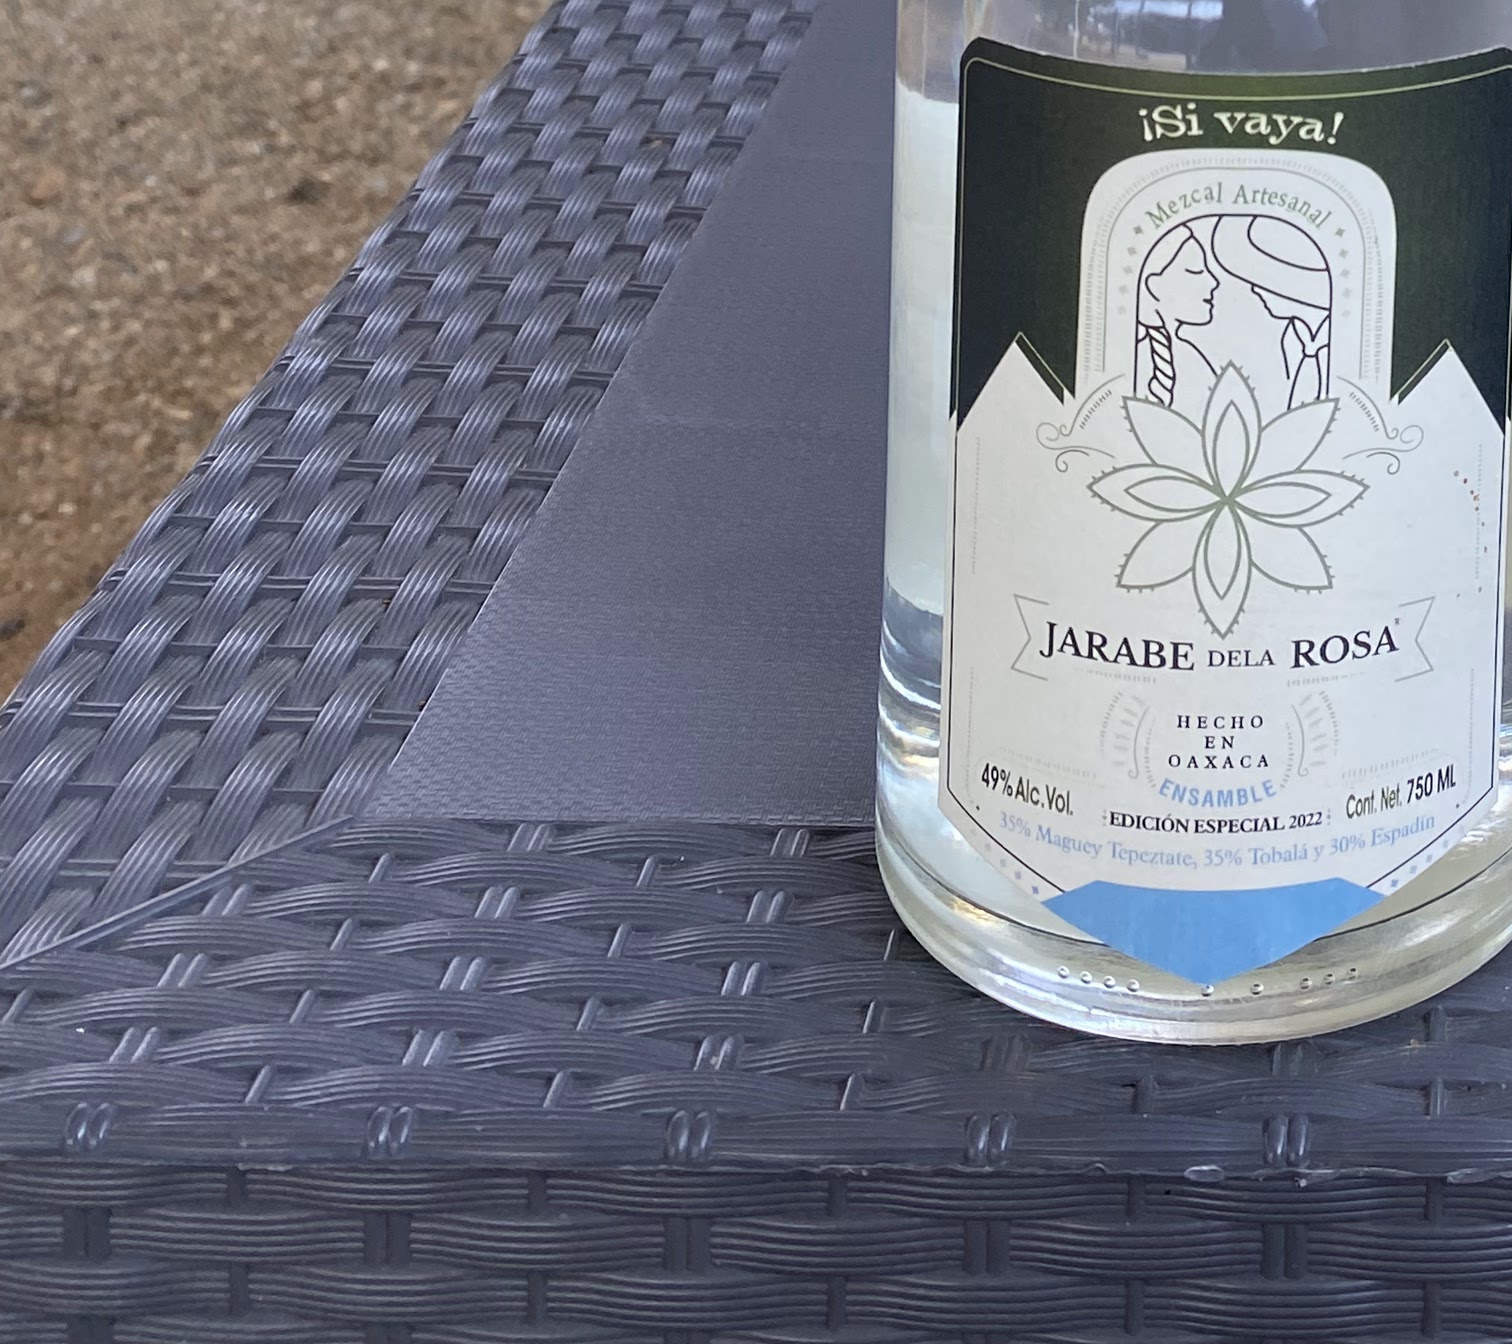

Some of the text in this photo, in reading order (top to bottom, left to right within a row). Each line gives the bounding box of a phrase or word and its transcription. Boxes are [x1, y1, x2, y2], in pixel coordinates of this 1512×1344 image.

[1138, 102, 1344, 145] ¡Si vaya!
[1145, 182, 1332, 229] Mezcal Artesanal
[1039, 621, 1195, 670] JARABE
[1290, 625, 1399, 669] ROSA
[1176, 715, 1264, 729] HECHO
[1204, 735, 1235, 749] EN
[1168, 754, 1269, 769] OAXACA
[1158, 778, 1277, 808] ENSAMBLE
[1346, 763, 1456, 819] Cont. Net. 750 ML
[1000, 812, 1435, 869] 35% Maguey Tepeztate, 35% Tobalá y 30% Espadín
[1110, 811, 1322, 834] EDICIÓN ESPECIAL 2022
